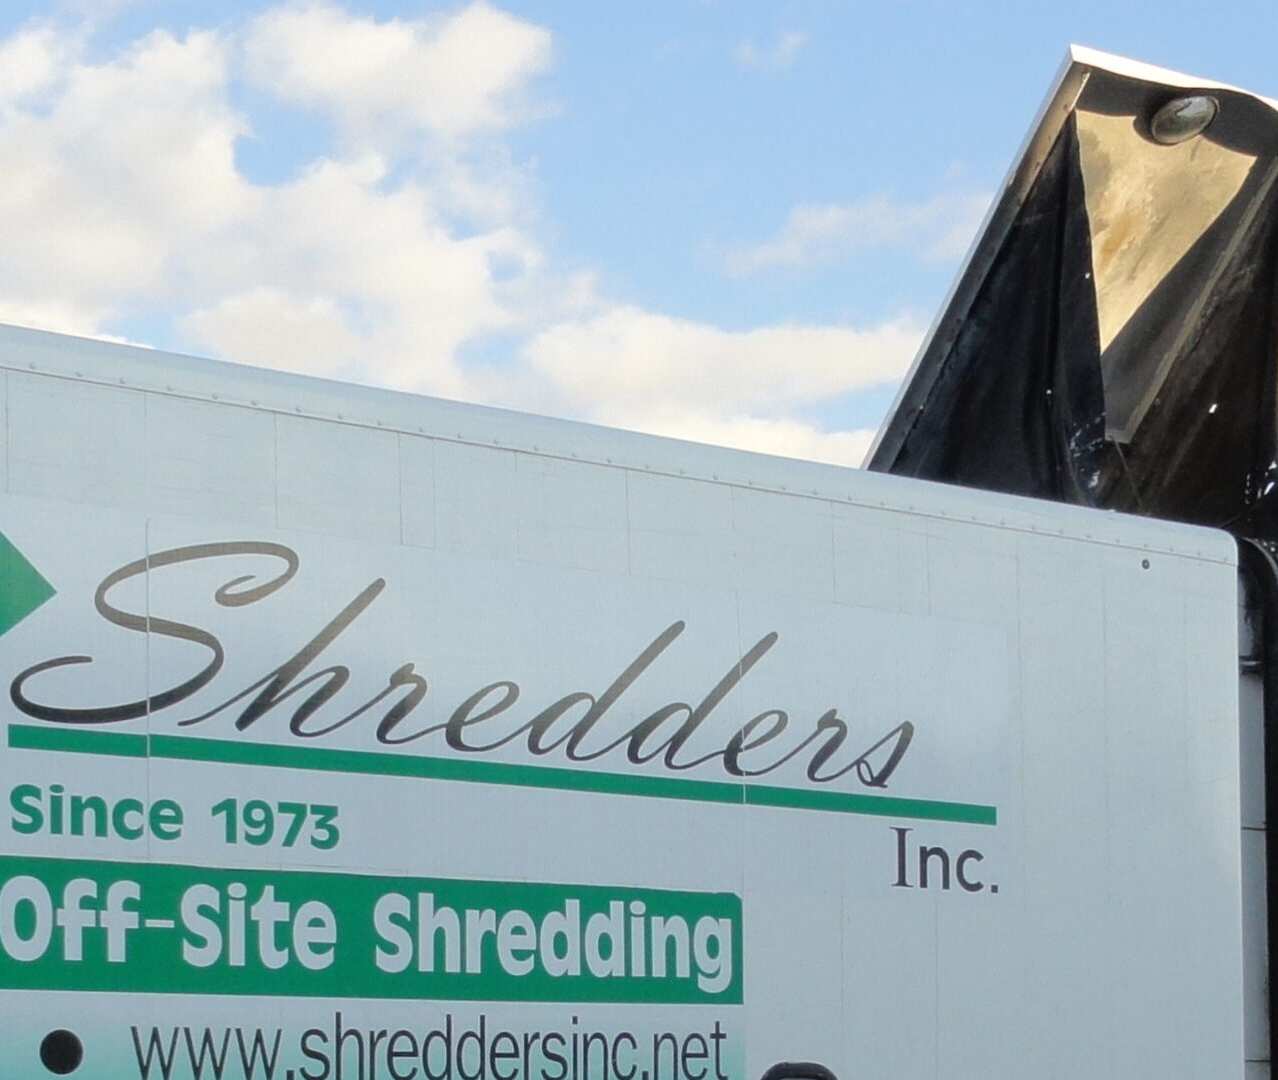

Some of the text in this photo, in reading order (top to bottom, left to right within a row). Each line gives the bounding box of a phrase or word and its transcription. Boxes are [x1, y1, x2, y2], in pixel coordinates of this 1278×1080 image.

[9, 540, 914, 788] Shredders
[9, 784, 339, 849] Since 1973
[889, 826, 999, 894] Inc.
[373, 892, 733, 994] Shredding
